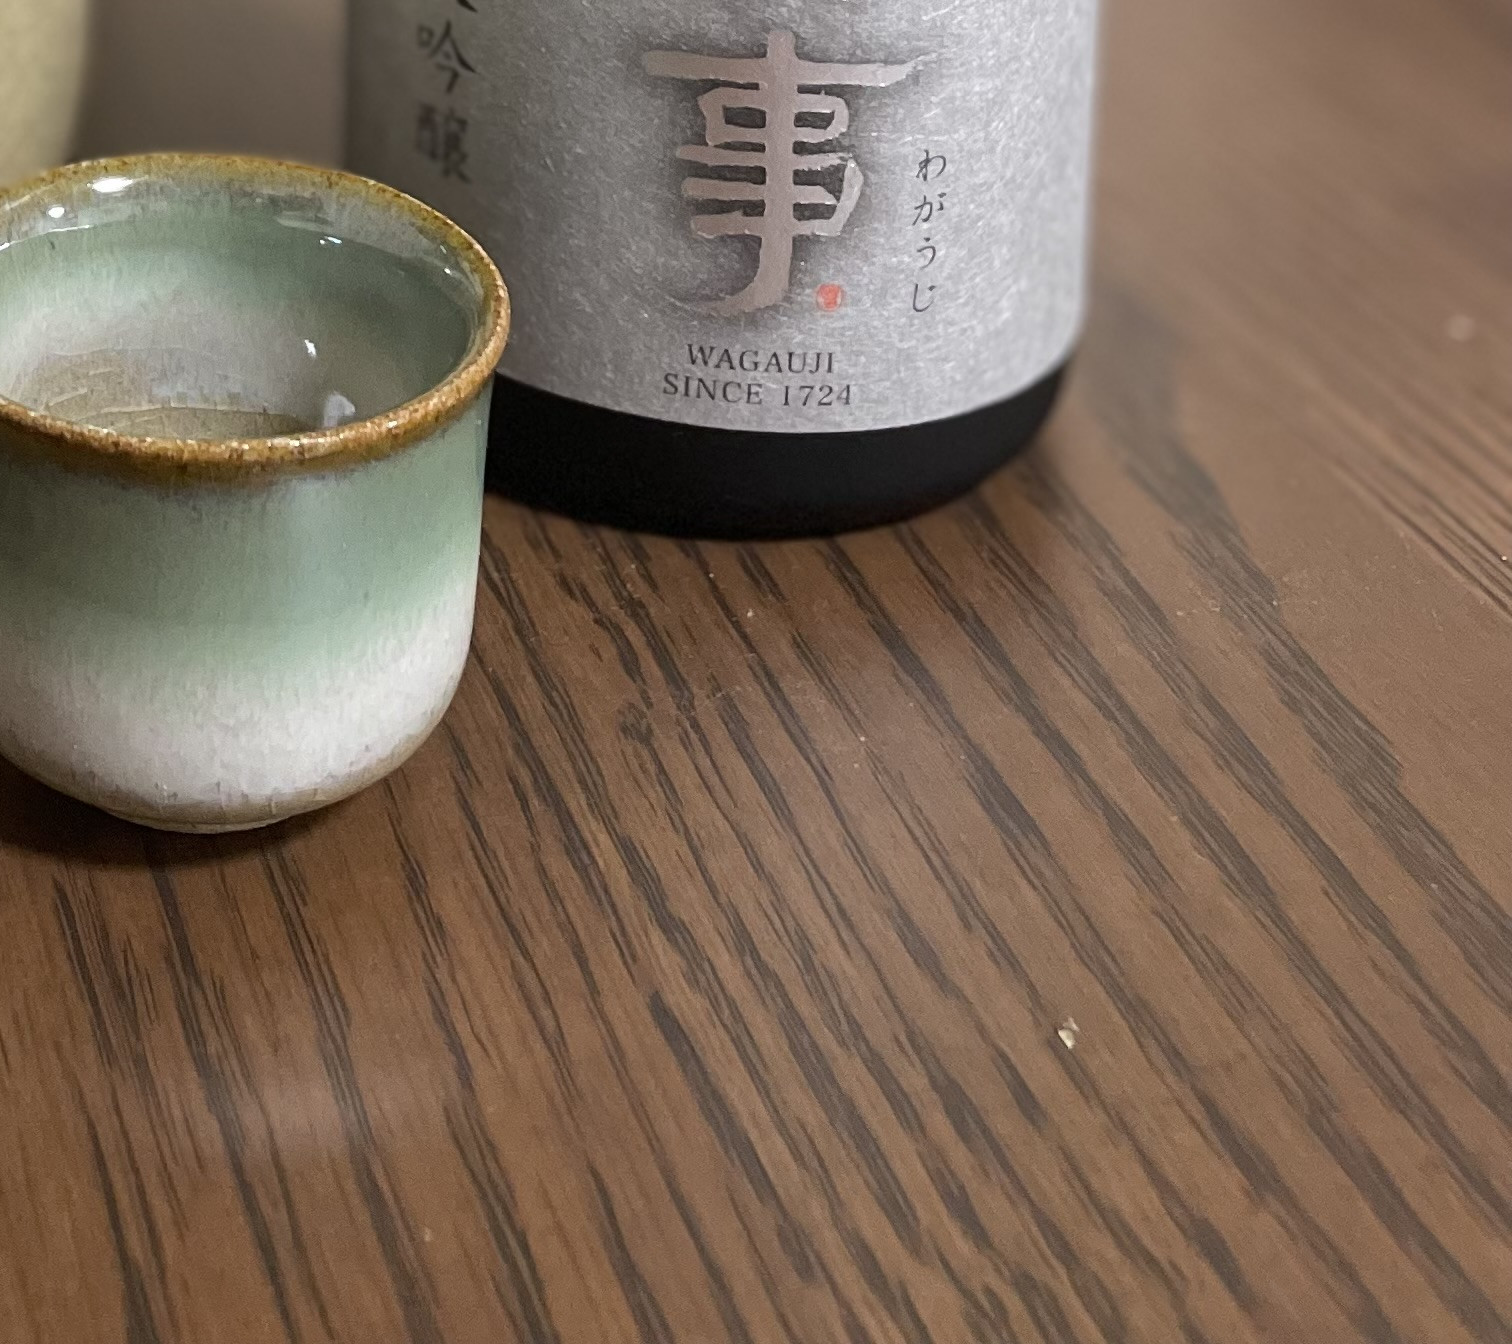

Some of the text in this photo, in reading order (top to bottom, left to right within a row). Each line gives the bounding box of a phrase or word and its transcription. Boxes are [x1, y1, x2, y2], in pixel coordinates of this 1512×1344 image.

[912, 149, 947, 313] わがうじ
[687, 343, 835, 374] WAGAUJI
[662, 372, 852, 407] SINCE 1724
